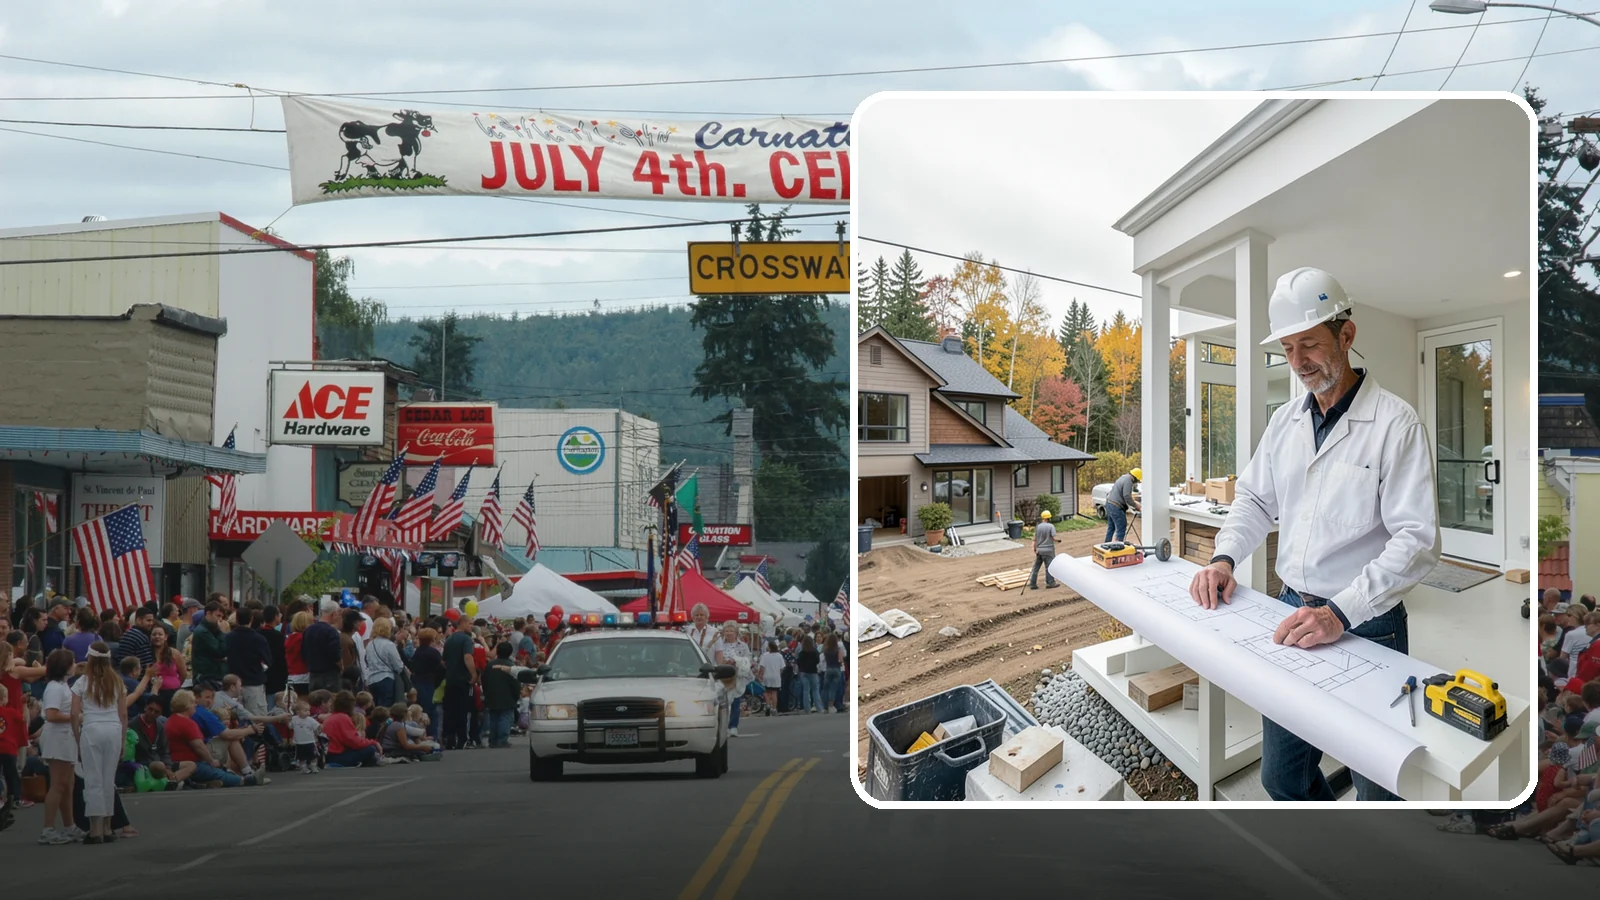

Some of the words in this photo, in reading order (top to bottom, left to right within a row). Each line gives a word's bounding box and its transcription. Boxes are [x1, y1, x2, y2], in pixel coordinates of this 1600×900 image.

[481, 141, 605, 193] JULY
[632, 150, 746, 198] 4th.
[697, 254, 850, 280] CROSSWA
[282, 380, 373, 420] ACE
[405, 409, 453, 422] CEDAR
[461, 409, 485, 422] LOG
[283, 421, 371, 437] Hardware
[416, 428, 477, 447] Coca-Cola
[353, 467, 385, 480] Simpl
[95, 485, 124, 495] Vincent
[126, 486, 136, 495] de
[138, 486, 155, 495] Paul
[212, 517, 331, 536] HARDARE
[688, 526, 742, 535] CRNATION
[699, 535, 730, 543] GLASS
